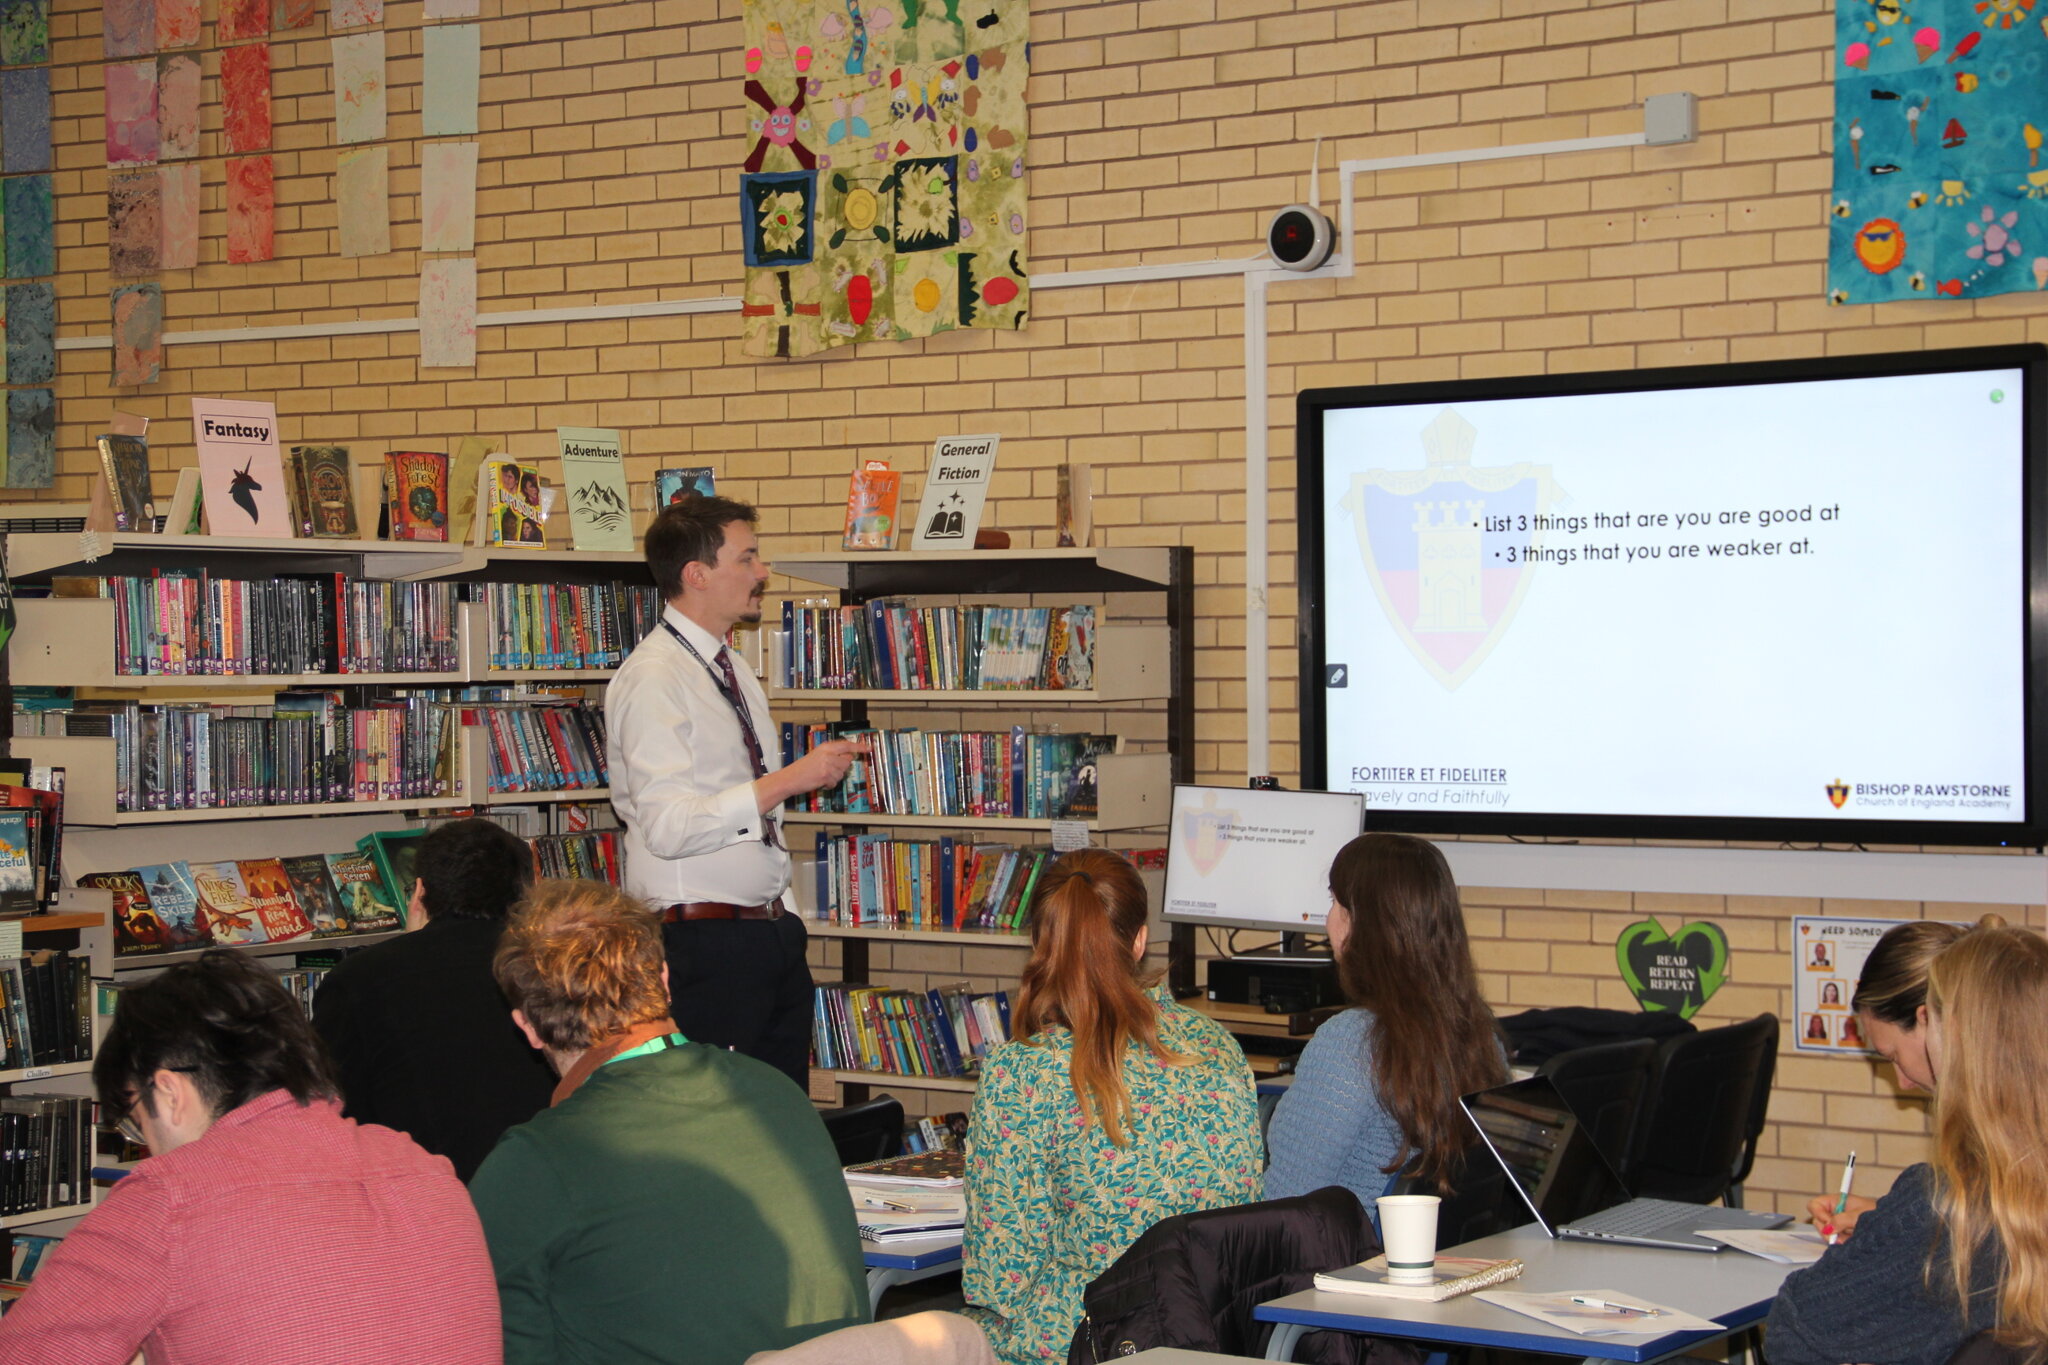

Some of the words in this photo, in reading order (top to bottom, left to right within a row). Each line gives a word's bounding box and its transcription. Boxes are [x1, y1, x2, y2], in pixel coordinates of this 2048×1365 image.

[204, 420, 269, 441] Fantasy
[564, 443, 619, 458] Adventure
[941, 442, 991, 456] General
[938, 467, 980, 480] Fiction
[1485, 515, 1512, 532] List
[1517, 515, 1527, 532] 3
[1533, 513, 1588, 534] things
[1594, 511, 1631, 528] that
[1637, 513, 1669, 527] are
[1675, 512, 1712, 530] you
[1718, 511, 1751, 524] are
[1758, 504, 1812, 527] good
[1819, 503, 1840, 521] at
[1507, 546, 1517, 562] 3
[1522, 545, 1577, 566] things
[1584, 543, 1620, 560] that
[1625, 545, 1661, 563] you
[1668, 544, 1700, 558] are
[1706, 539, 1782, 557] weaker
[1789, 537, 1815, 555] at.
[785, 611, 792, 619] A
[876, 610, 882, 618] B
[785, 732, 791, 740] C
[535, 727, 549, 759] SILVERFIN
[1351, 766, 1415, 781] FORTITER
[1421, 768, 1435, 781] ET
[1440, 768, 1508, 782] FIDELITER
[1856, 783, 1911, 796] BISHOP
[1914, 784, 2012, 797] RAWSTORNE
[1407, 789, 1439, 803] and
[1442, 789, 1510, 807] Faithfully
[1856, 796, 1895, 807] Church
[1897, 797, 1909, 807] of
[1911, 797, 1955, 809] England
[1959, 799, 2012, 810] Academy
[943, 847, 950, 855] G
[0, 857, 26, 867] ceful
[343, 872, 371, 881] Seven
[200, 878, 237, 891] WINGS
[211, 891, 237, 904] FIRE
[158, 905, 195, 918] SKIES
[1849, 927, 1882, 936] SOMEO
[1656, 955, 1688, 966] READ
[1649, 967, 1695, 979] RETURN
[1650, 979, 1695, 991] REPEAT
[1000, 1000, 1007, 1010] K
[26, 1069, 50, 1078] Chillers
